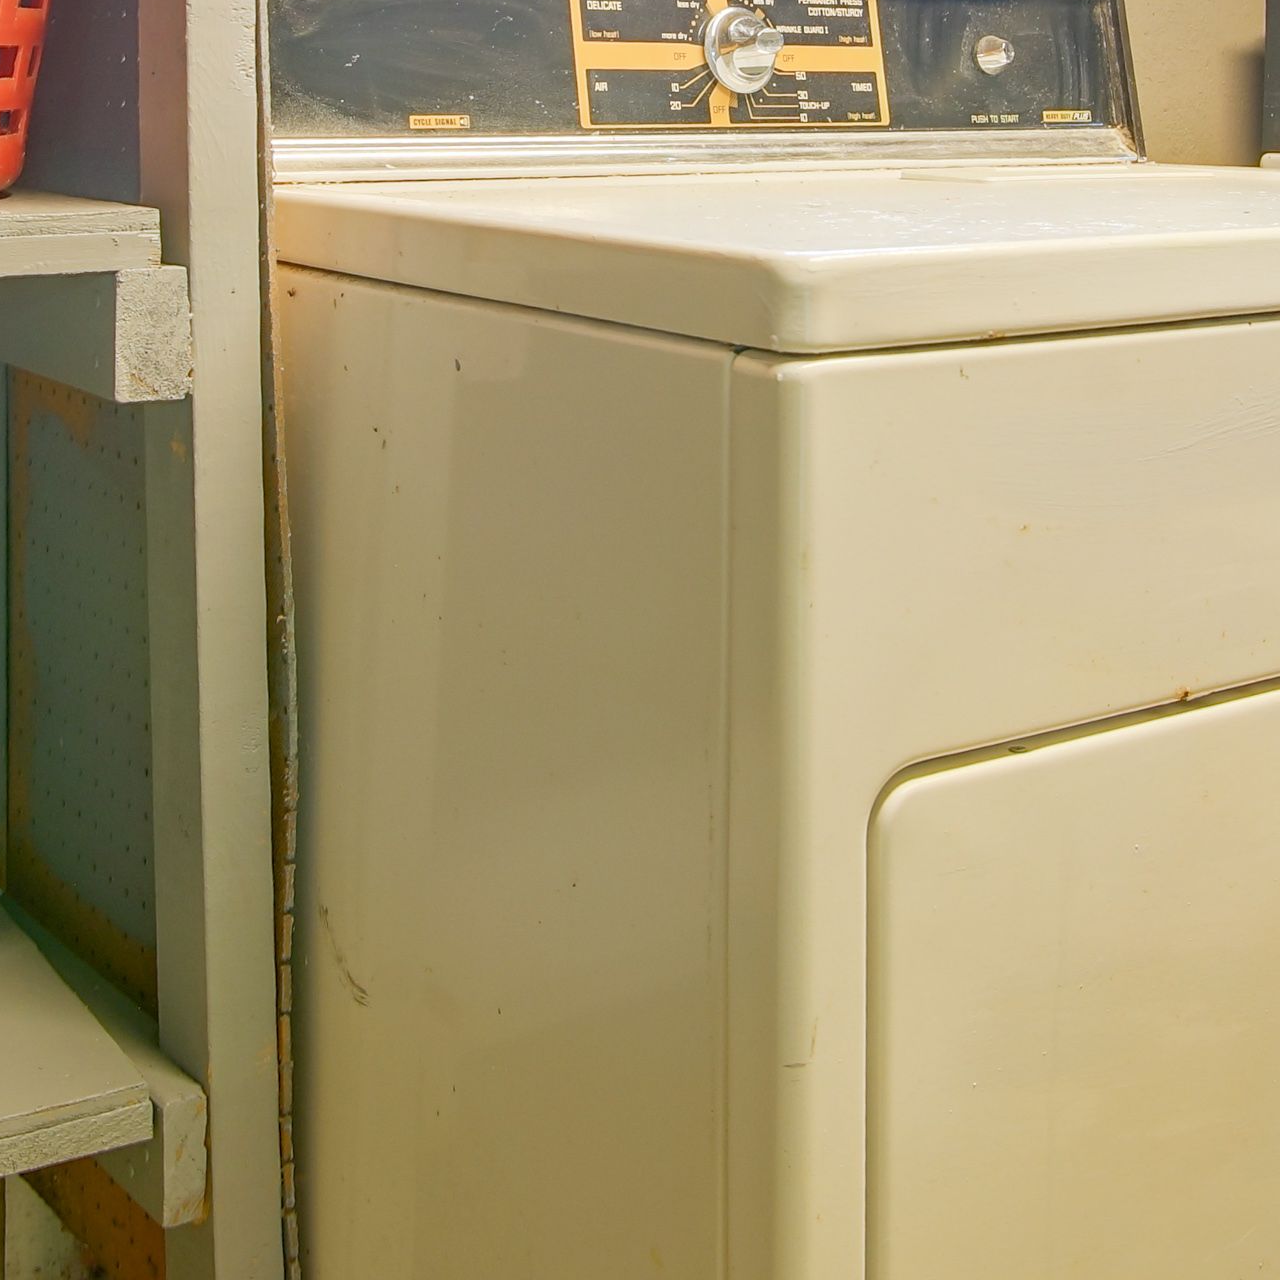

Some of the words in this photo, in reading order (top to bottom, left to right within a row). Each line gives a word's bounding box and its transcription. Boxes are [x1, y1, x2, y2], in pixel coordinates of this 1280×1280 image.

[586, 0, 622, 11] DELICATE
[690, 0, 700, 9] dry
[807, 7, 864, 17] COTTON/STURDY
[803, 26, 824, 34] GUARD
[678, 32, 688, 41] dry
[673, 52, 687, 61] OFF
[782, 54, 795, 62] OFF
[795, 71, 807, 81] 50
[594, 82, 608, 92] AIR
[850, 82, 873, 92] TIMED
[797, 90, 809, 100] 30
[669, 101, 681, 110] 20
[712, 106, 726, 114] OFF
[799, 101, 830, 110] TOUCH-UP
[413, 118, 431, 126] CYCLE
[435, 118, 457, 126] SIGNAL
[800, 113, 808, 122] 10
[970, 114, 989, 124] PUSH
[990, 114, 999, 124] TO
[1000, 114, 1019, 123] START
